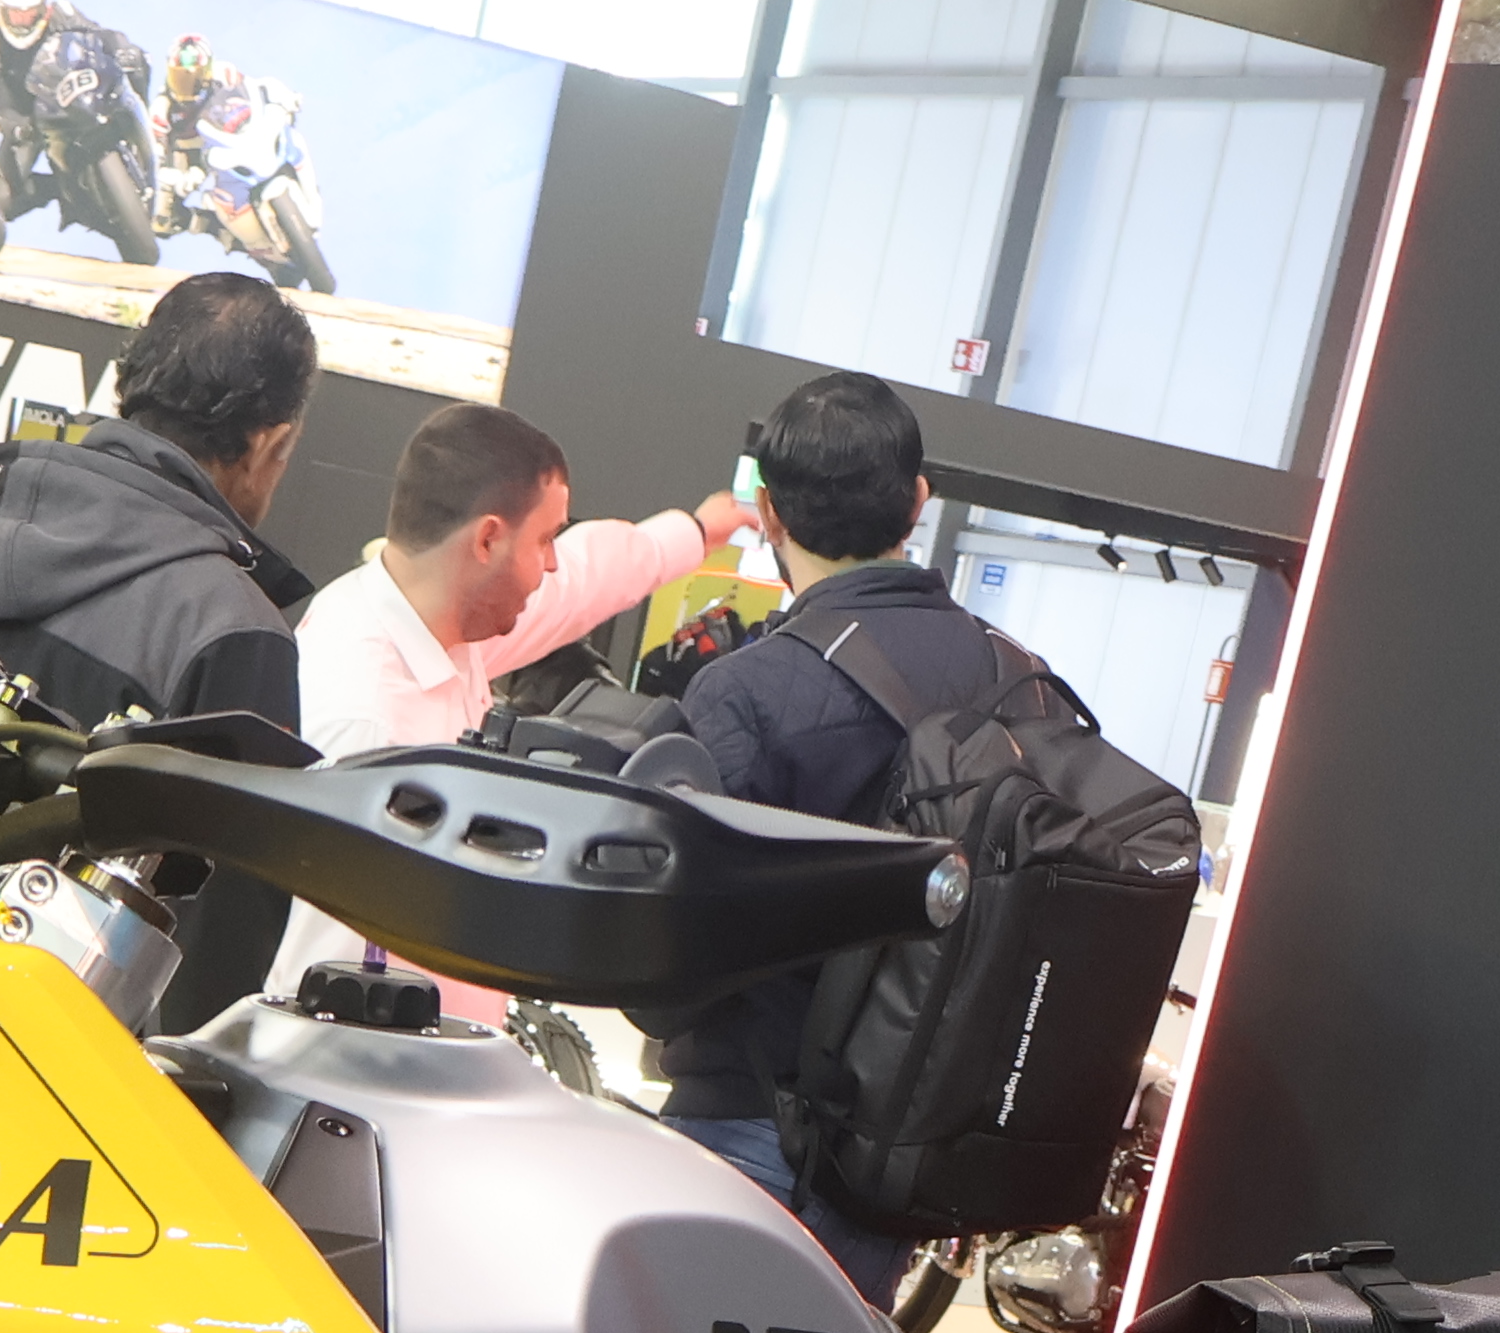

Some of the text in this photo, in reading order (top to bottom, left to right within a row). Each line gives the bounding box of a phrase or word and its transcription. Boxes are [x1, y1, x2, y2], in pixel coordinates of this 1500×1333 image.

[997, 960, 1052, 1128] experience more together
